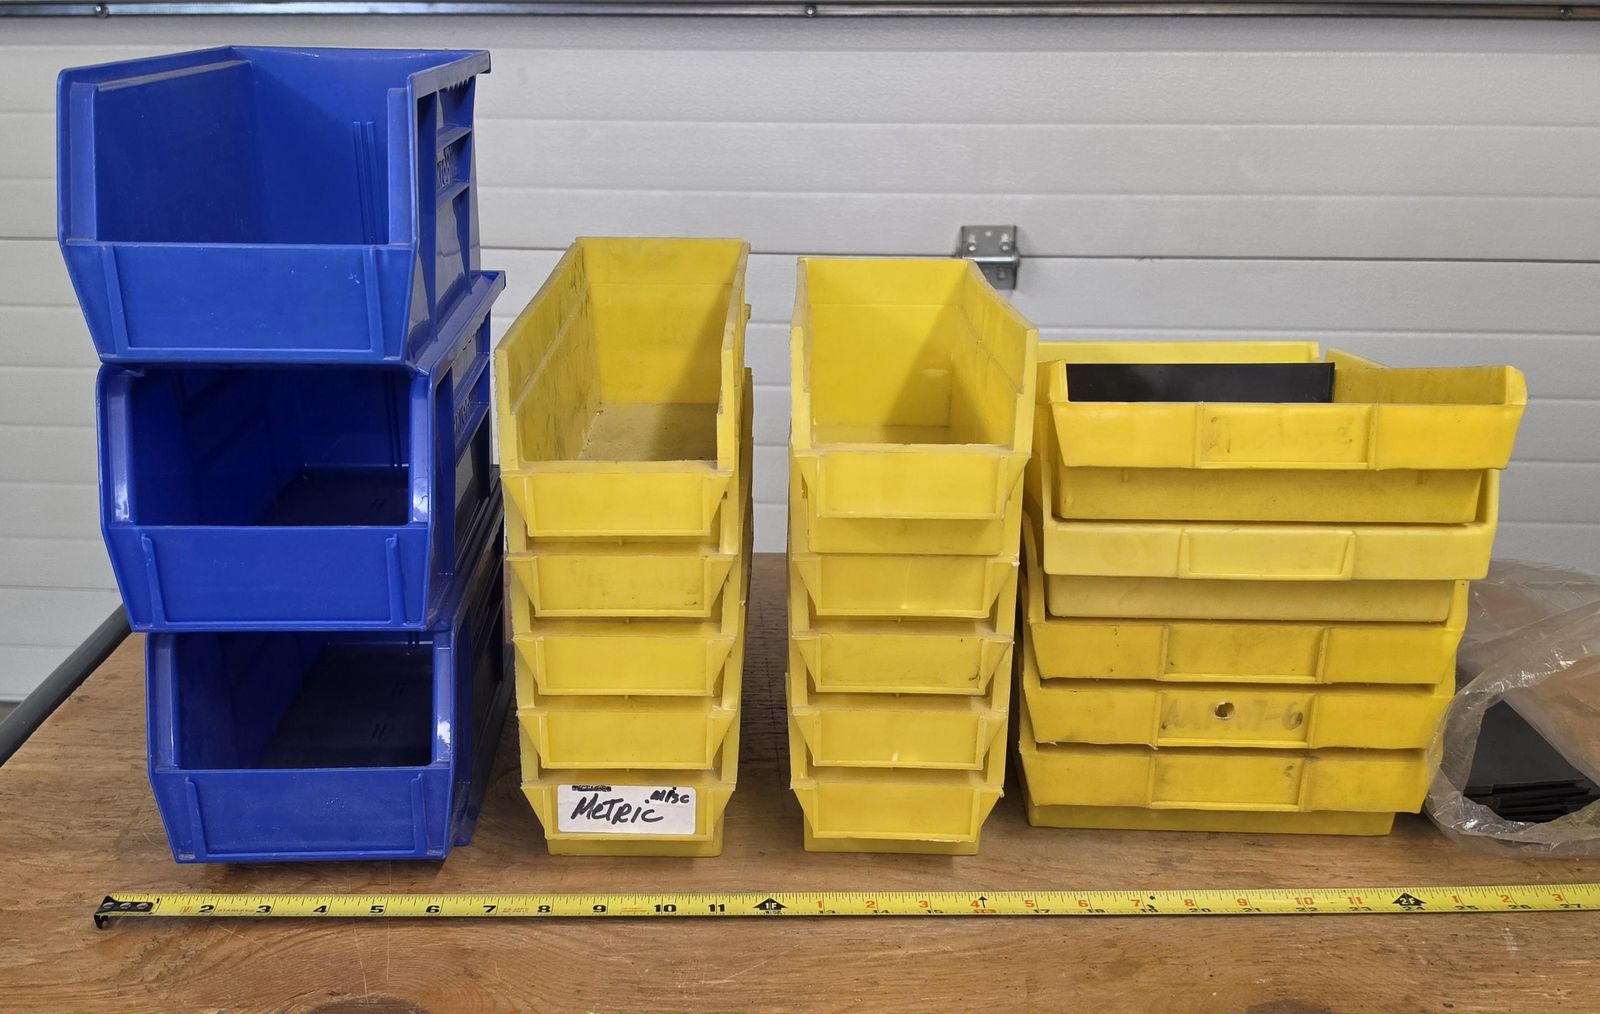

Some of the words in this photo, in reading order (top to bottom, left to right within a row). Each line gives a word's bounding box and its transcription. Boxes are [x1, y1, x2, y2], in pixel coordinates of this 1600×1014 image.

[198, 904, 214, 912] 2
[256, 905, 272, 913] 3
[313, 905, 328, 913] 4
[370, 905, 384, 913] 5
[426, 905, 440, 913] 6
[482, 904, 496, 912] 7
[537, 904, 551, 912] 8
[592, 904, 606, 912] 9
[654, 904, 676, 912] 10
[708, 904, 726, 912] 11
[816, 900, 823, 908] 1
[866, 900, 876, 908] 2
[919, 900, 929, 908] 3
[970, 900, 980, 908] 4
[1024, 900, 1035, 908] 5
[1078, 900, 1088, 908] 6
[1130, 899, 1140, 907] 7
[1184, 898, 1195, 907] 8
[1236, 898, 1248, 906] 9
[1294, 896, 1314, 906] 10
[1347, 896, 1363, 905] 11
[1452, 895, 1460, 904] 1
[1500, 894, 1512, 903] 2
[1552, 893, 1564, 902] 3
